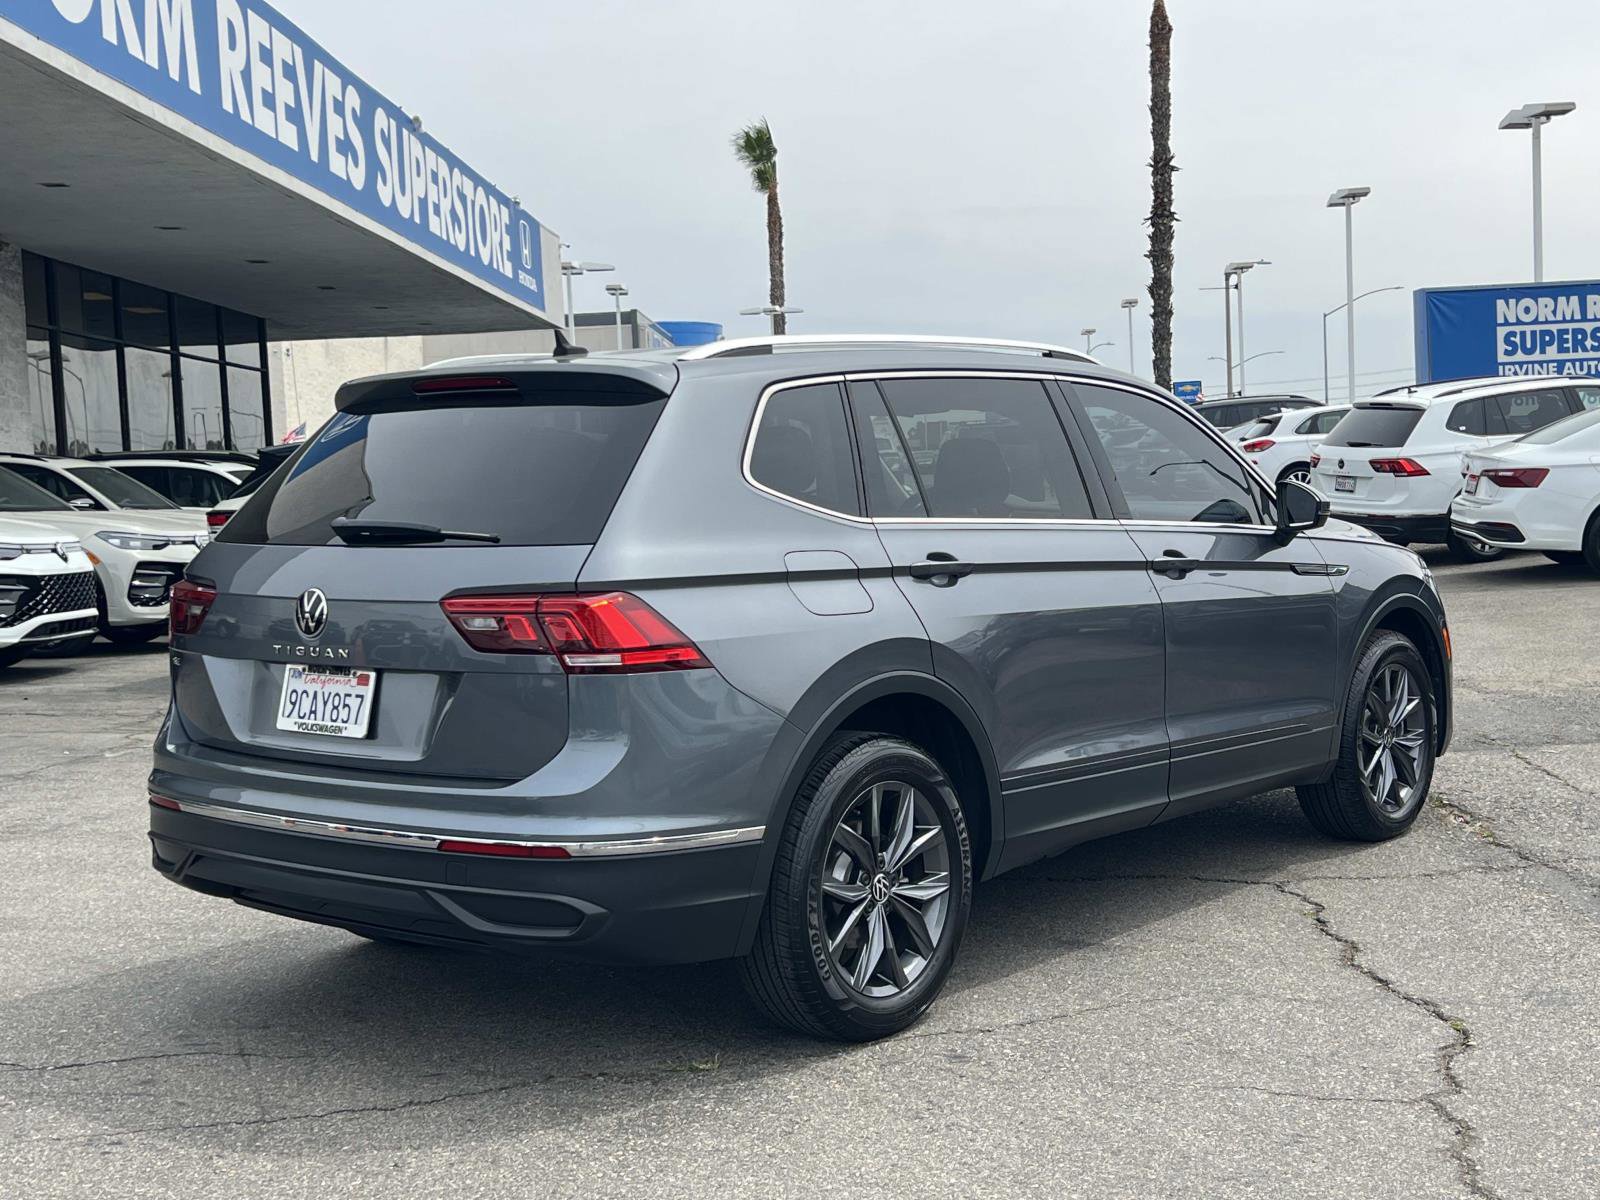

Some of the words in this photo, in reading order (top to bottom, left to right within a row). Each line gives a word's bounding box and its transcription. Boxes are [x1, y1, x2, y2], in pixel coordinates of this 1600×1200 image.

[216, 0, 366, 191] REEVES
[374, 107, 513, 279] SUPERSTORE
[1496, 295, 1581, 324] NORM
[1498, 362, 1558, 377] IRVINE
[1562, 360, 1600, 376] AUT
[273, 644, 349, 659] TIGUAN
[286, 688, 365, 725] 9CAY857
